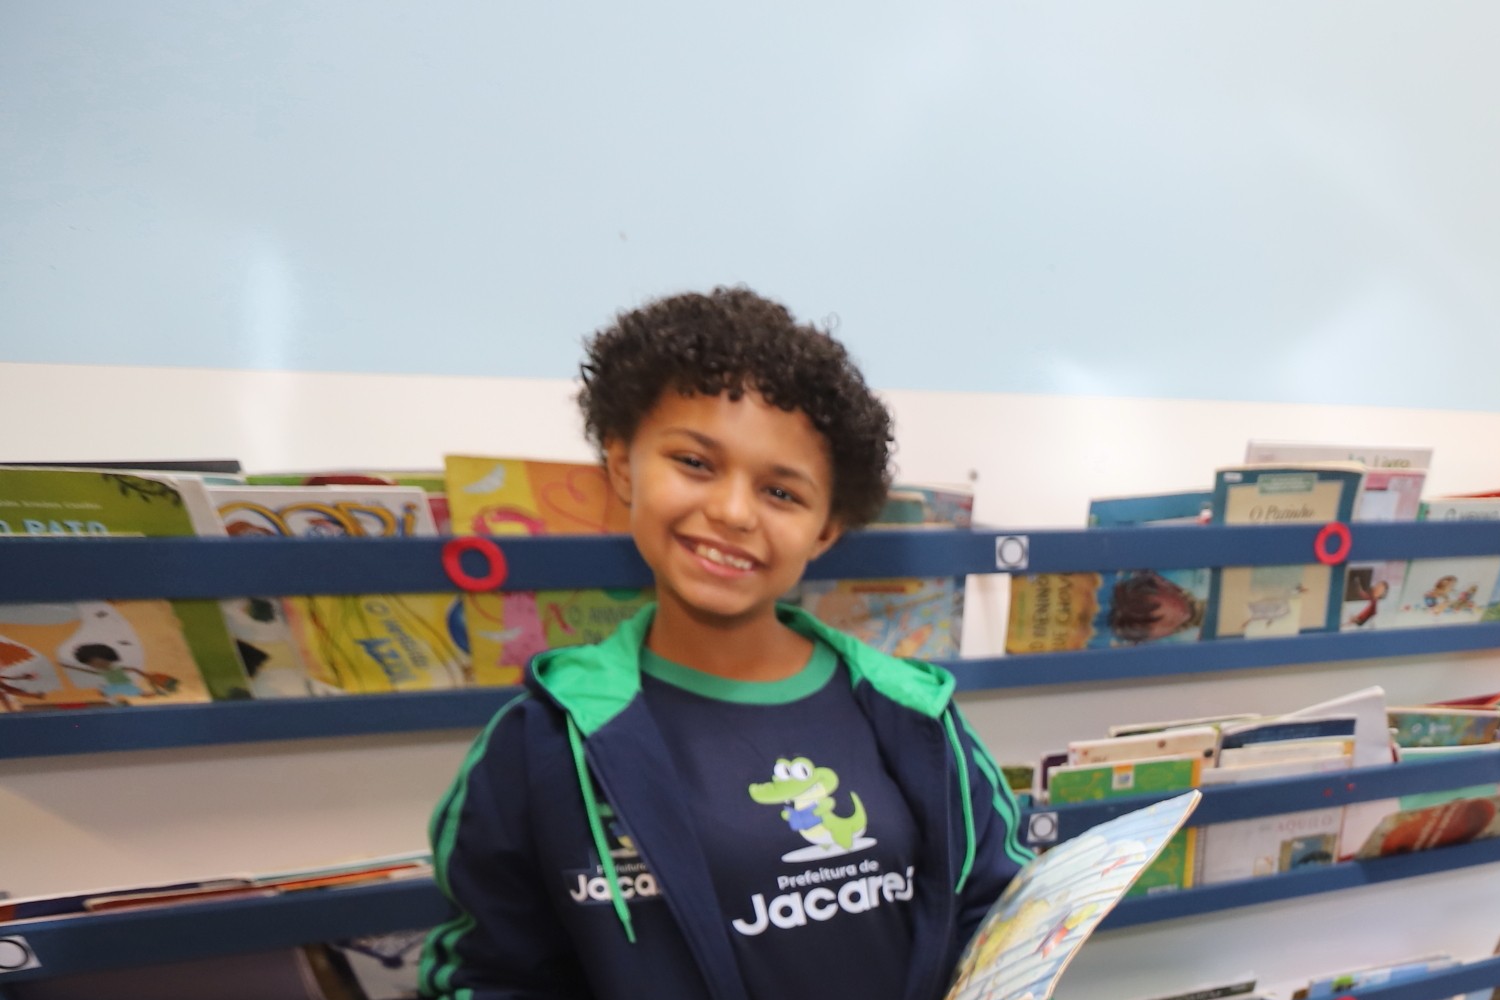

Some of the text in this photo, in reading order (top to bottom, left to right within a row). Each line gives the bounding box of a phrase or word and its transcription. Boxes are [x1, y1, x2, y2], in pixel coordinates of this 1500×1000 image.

[569, 873, 659, 903] Jaca
[777, 859, 880, 890] Prefeitura de
